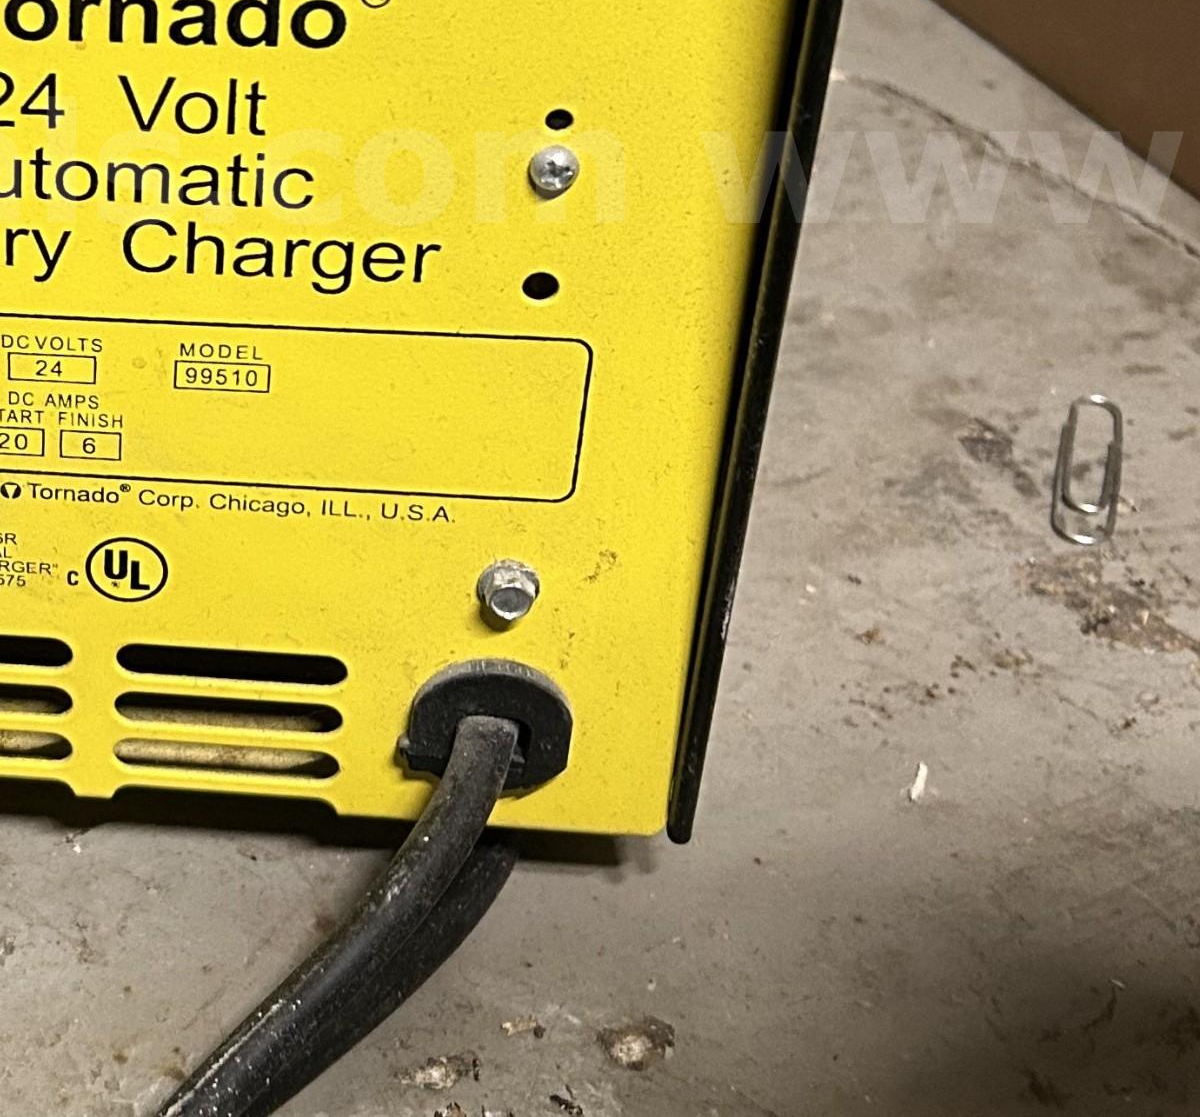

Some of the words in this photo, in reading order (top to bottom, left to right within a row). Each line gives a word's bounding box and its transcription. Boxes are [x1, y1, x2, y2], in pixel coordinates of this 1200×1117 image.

[117, 74, 268, 137] Volt
[122, 218, 443, 295] Charger
[1, 333, 30, 350] DC
[34, 334, 104, 354] VOLTS
[178, 342, 264, 361] MODEL
[35, 359, 64, 378] 24
[184, 367, 259, 388] 99510
[7, 390, 37, 407] DC
[43, 392, 100, 410] AMPS
[57, 410, 124, 429] FINISH
[82, 436, 97, 455] 6
[137, 488, 202, 513] Corp.
[208, 492, 312, 518] Chicago,
[380, 501, 457, 524] U.S.A.
[102, 548, 151, 591] UL
